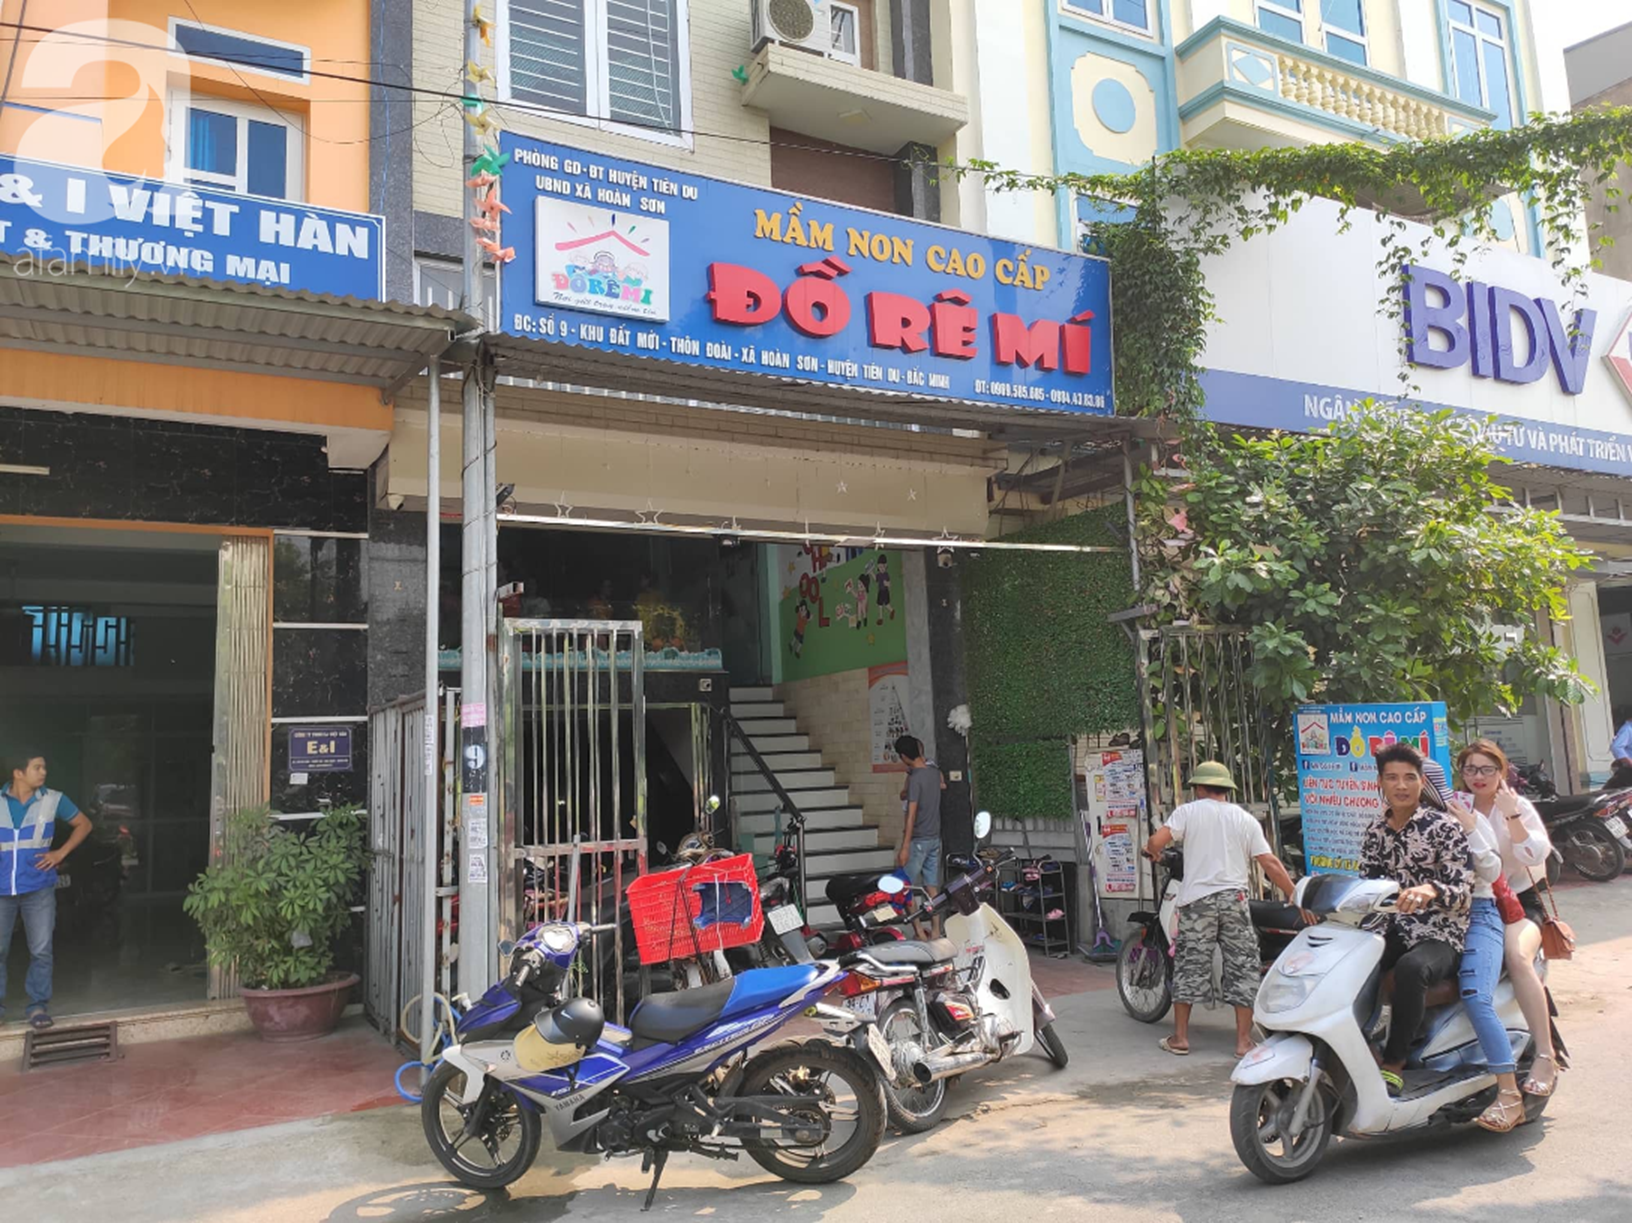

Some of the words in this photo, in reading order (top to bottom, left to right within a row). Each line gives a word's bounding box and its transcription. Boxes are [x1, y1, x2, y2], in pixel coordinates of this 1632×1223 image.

[514, 148, 558, 171] PHÒNG
[608, 168, 648, 191] HUYỆN
[652, 177, 678, 196] TIÊN
[682, 184, 698, 200] DU
[535, 175, 571, 196] UBND
[575, 182, 592, 200] XÃ
[597, 187, 631, 208] HOÀN
[640, 197, 665, 215] SƠN
[66, 177, 87, 215] I
[108, 184, 239, 238] VIỆT
[259, 209, 369, 261] HÀN
[754, 202, 834, 252] MẦM
[847, 227, 914, 267] NON
[926, 245, 986, 281] CAO
[995, 248, 1050, 291] CẤP
[23, 228, 53, 251] &
[65, 230, 214, 274] THƯƠNG
[226, 255, 291, 286] MẠI
[707, 255, 852, 337] ĐỒ
[866, 288, 979, 360] RÊ
[992, 310, 1096, 376] MÍ
[1402, 263, 1598, 396] BIDV
[539, 312, 555, 335] SỐ
[560, 320, 568, 337] 9
[579, 323, 604, 342] KHU
[609, 323, 631, 346] ĐẤT
[636, 329, 659, 350] MỚI
[670, 335, 699, 356] THÔN
[706, 340, 731, 361] ĐOÀI
[741, 345, 756, 364] XÃ
[761, 348, 790, 369] HOÀN
[796, 355, 818, 373] SƠN
[827, 359, 858, 380] HUYỆN
[862, 362, 882, 380] TIÊN
[887, 367, 900, 382] DU
[907, 365, 925, 386] BẮC
[1527, 427, 1547, 451] VÀ
[1549, 432, 1585, 456] PHÁT
[1587, 435, 1626, 462] TRIỂN
[1355, 712, 1377, 723] NON
[1380, 711, 1401, 723] CAO
[1405, 706, 1427, 723] CẤP
[307, 740, 335, 754] E&I
